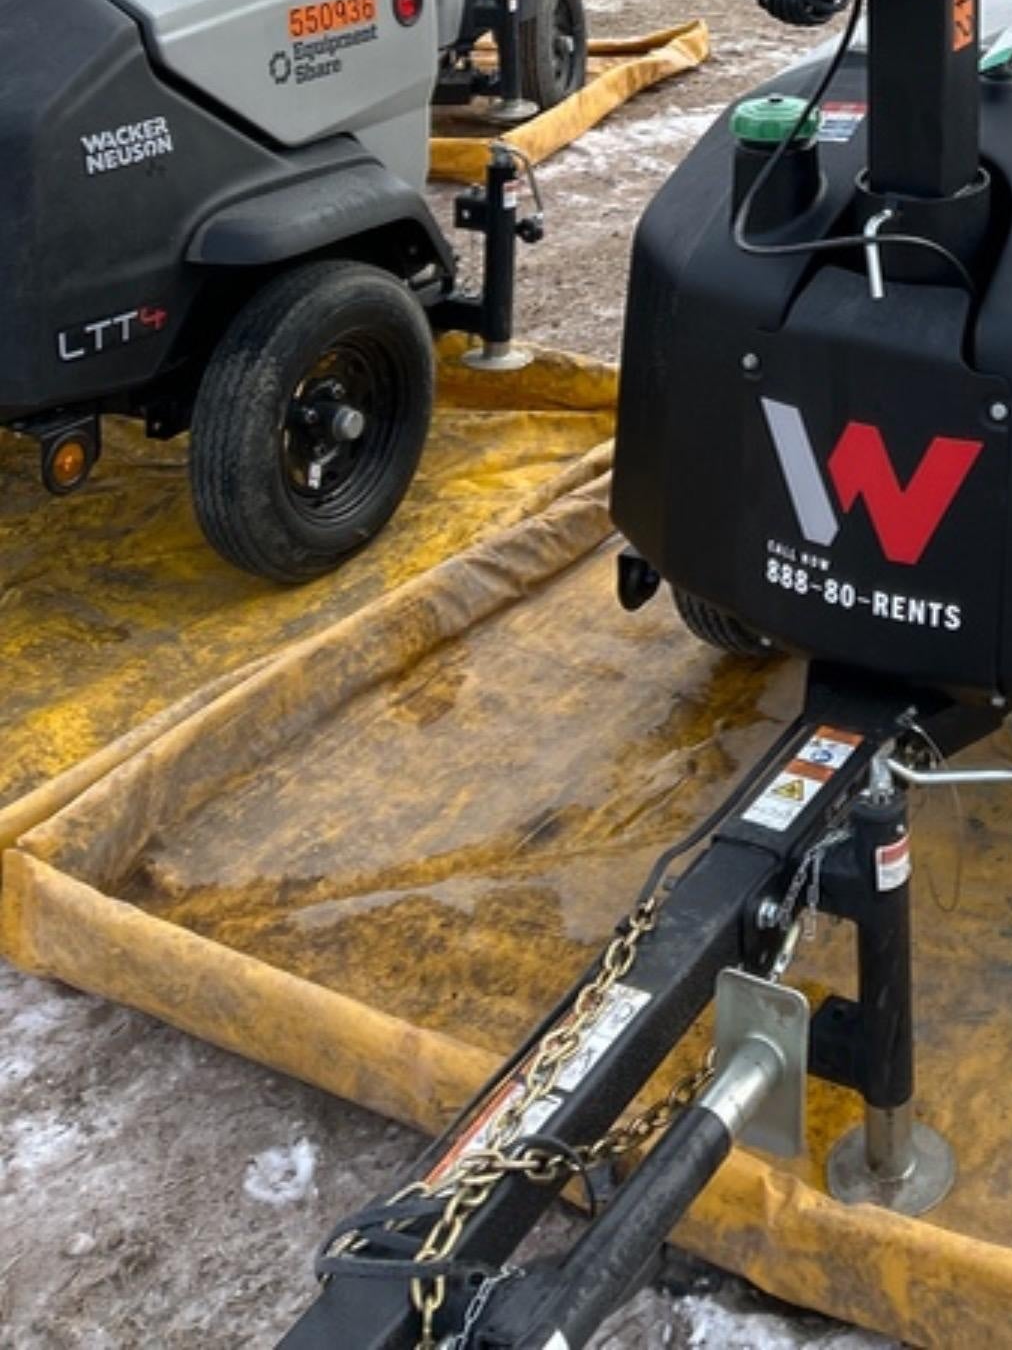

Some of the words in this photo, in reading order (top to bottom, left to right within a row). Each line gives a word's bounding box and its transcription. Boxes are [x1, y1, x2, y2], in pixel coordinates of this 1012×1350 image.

[293, 23, 378, 61] Equipment
[295, 59, 342, 84] Share
[80, 116, 169, 154] WACKER
[86, 134, 174, 175] NEUSON
[58, 306, 168, 361] LTT4
[766, 558, 962, 630] 888-80-RENTS
